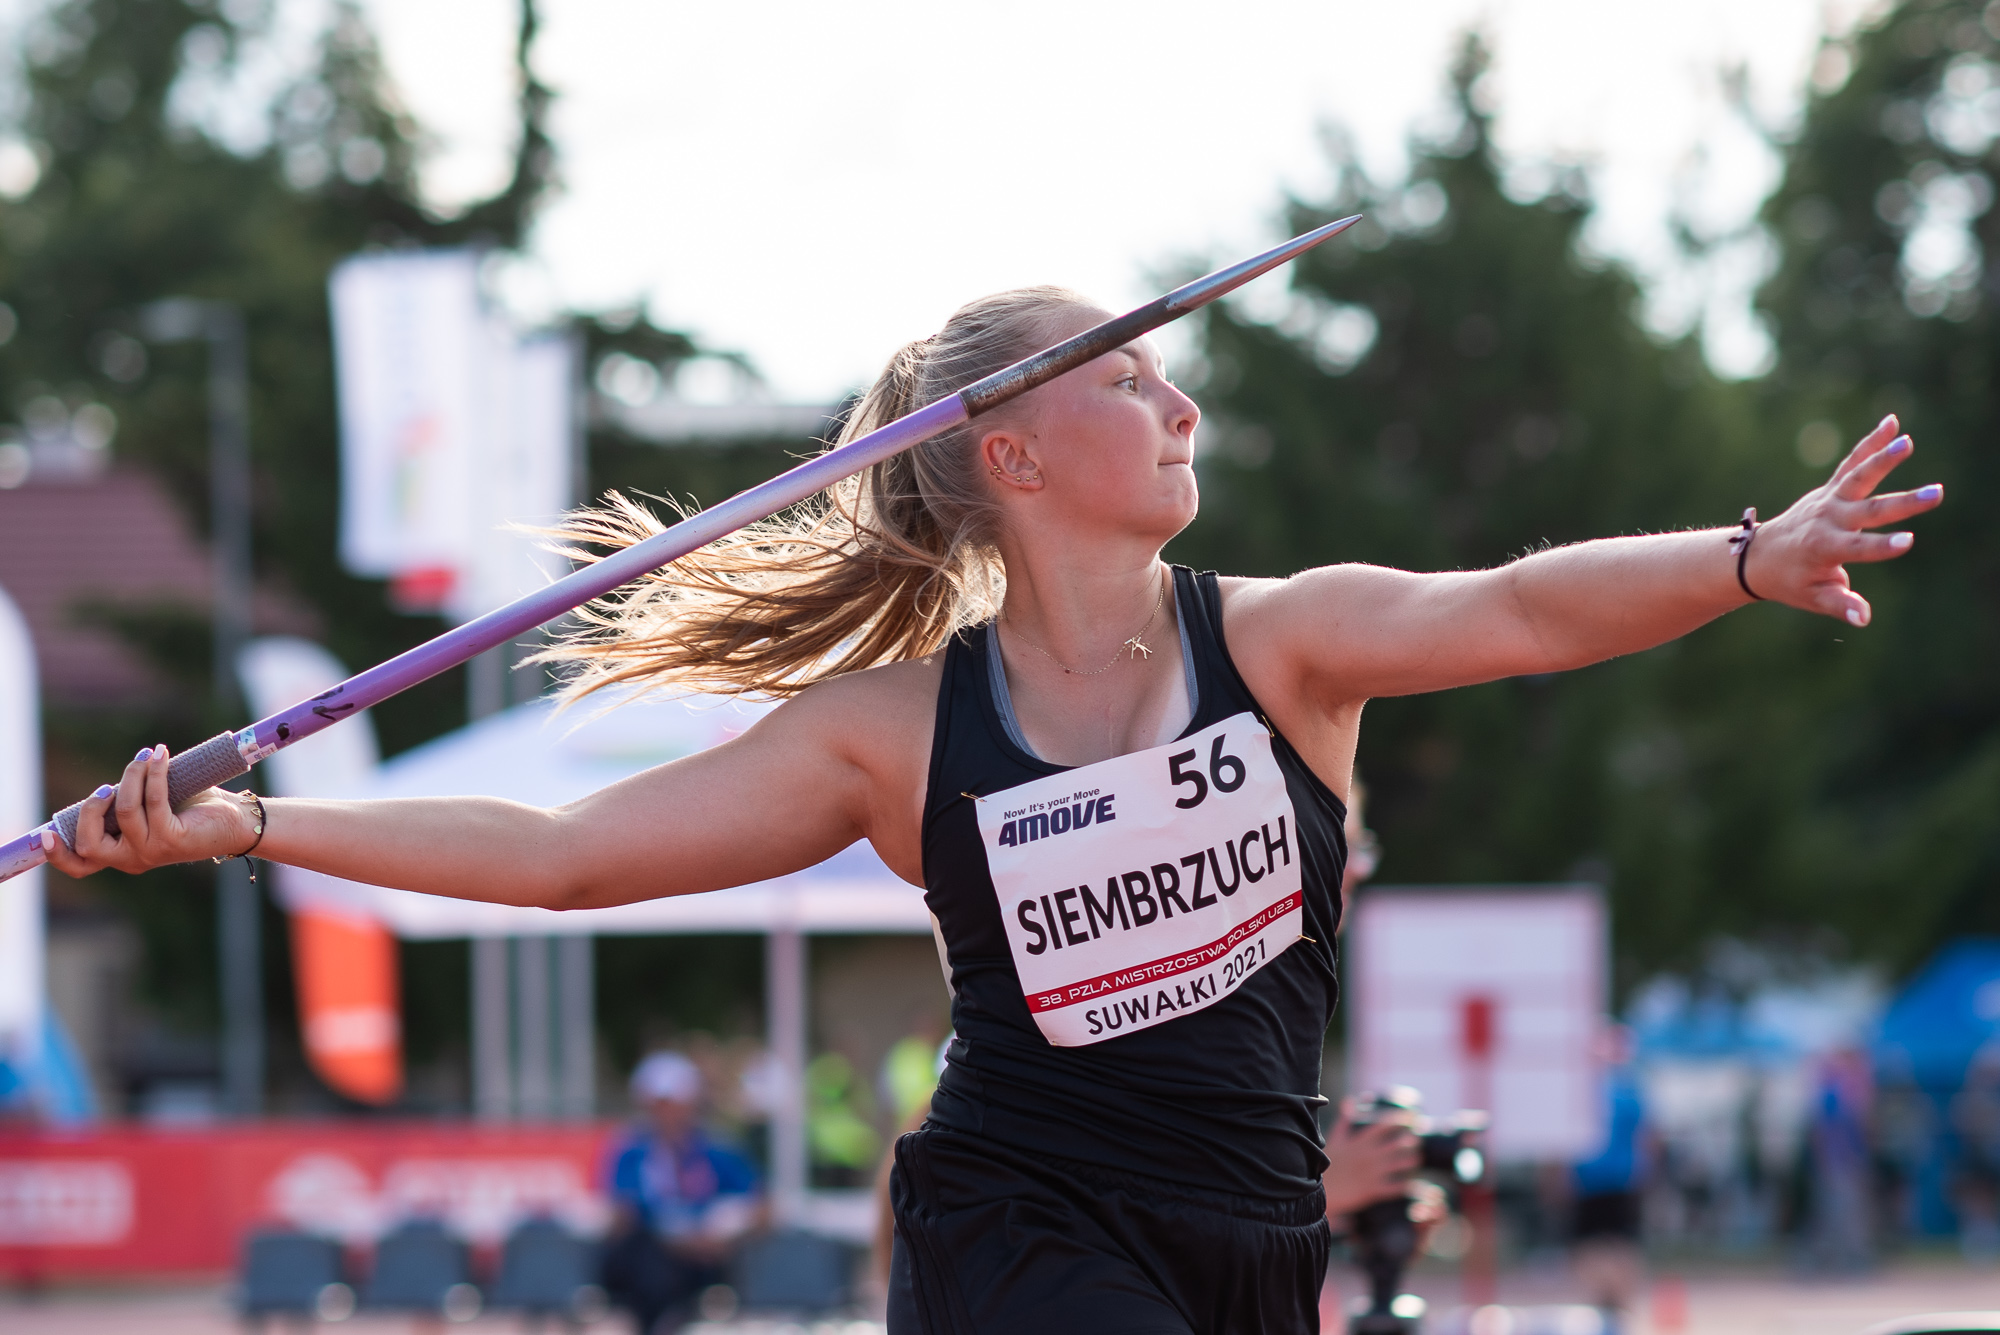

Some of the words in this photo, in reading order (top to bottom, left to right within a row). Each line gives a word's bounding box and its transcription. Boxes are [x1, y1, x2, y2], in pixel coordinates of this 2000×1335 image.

[1003, 807, 1027, 820] Now
[1029, 802, 1045, 813] It's
[1047, 795, 1071, 810] your
[1073, 788, 1100, 801] Move
[1168, 733, 1247, 810] 56
[998, 793, 1116, 848] 4MOVE
[1017, 814, 1291, 956] SIEMBRZUCH
[1038, 992, 1067, 1008] 38.
[1068, 979, 1113, 1000] PZLA
[1115, 942, 1228, 987] MISTRZOSTWA
[1227, 914, 1266, 947] POLSKI
[1268, 898, 1294, 920] U23
[1085, 973, 1218, 1036] SUWAŁKI
[1222, 937, 1266, 990] 2021
